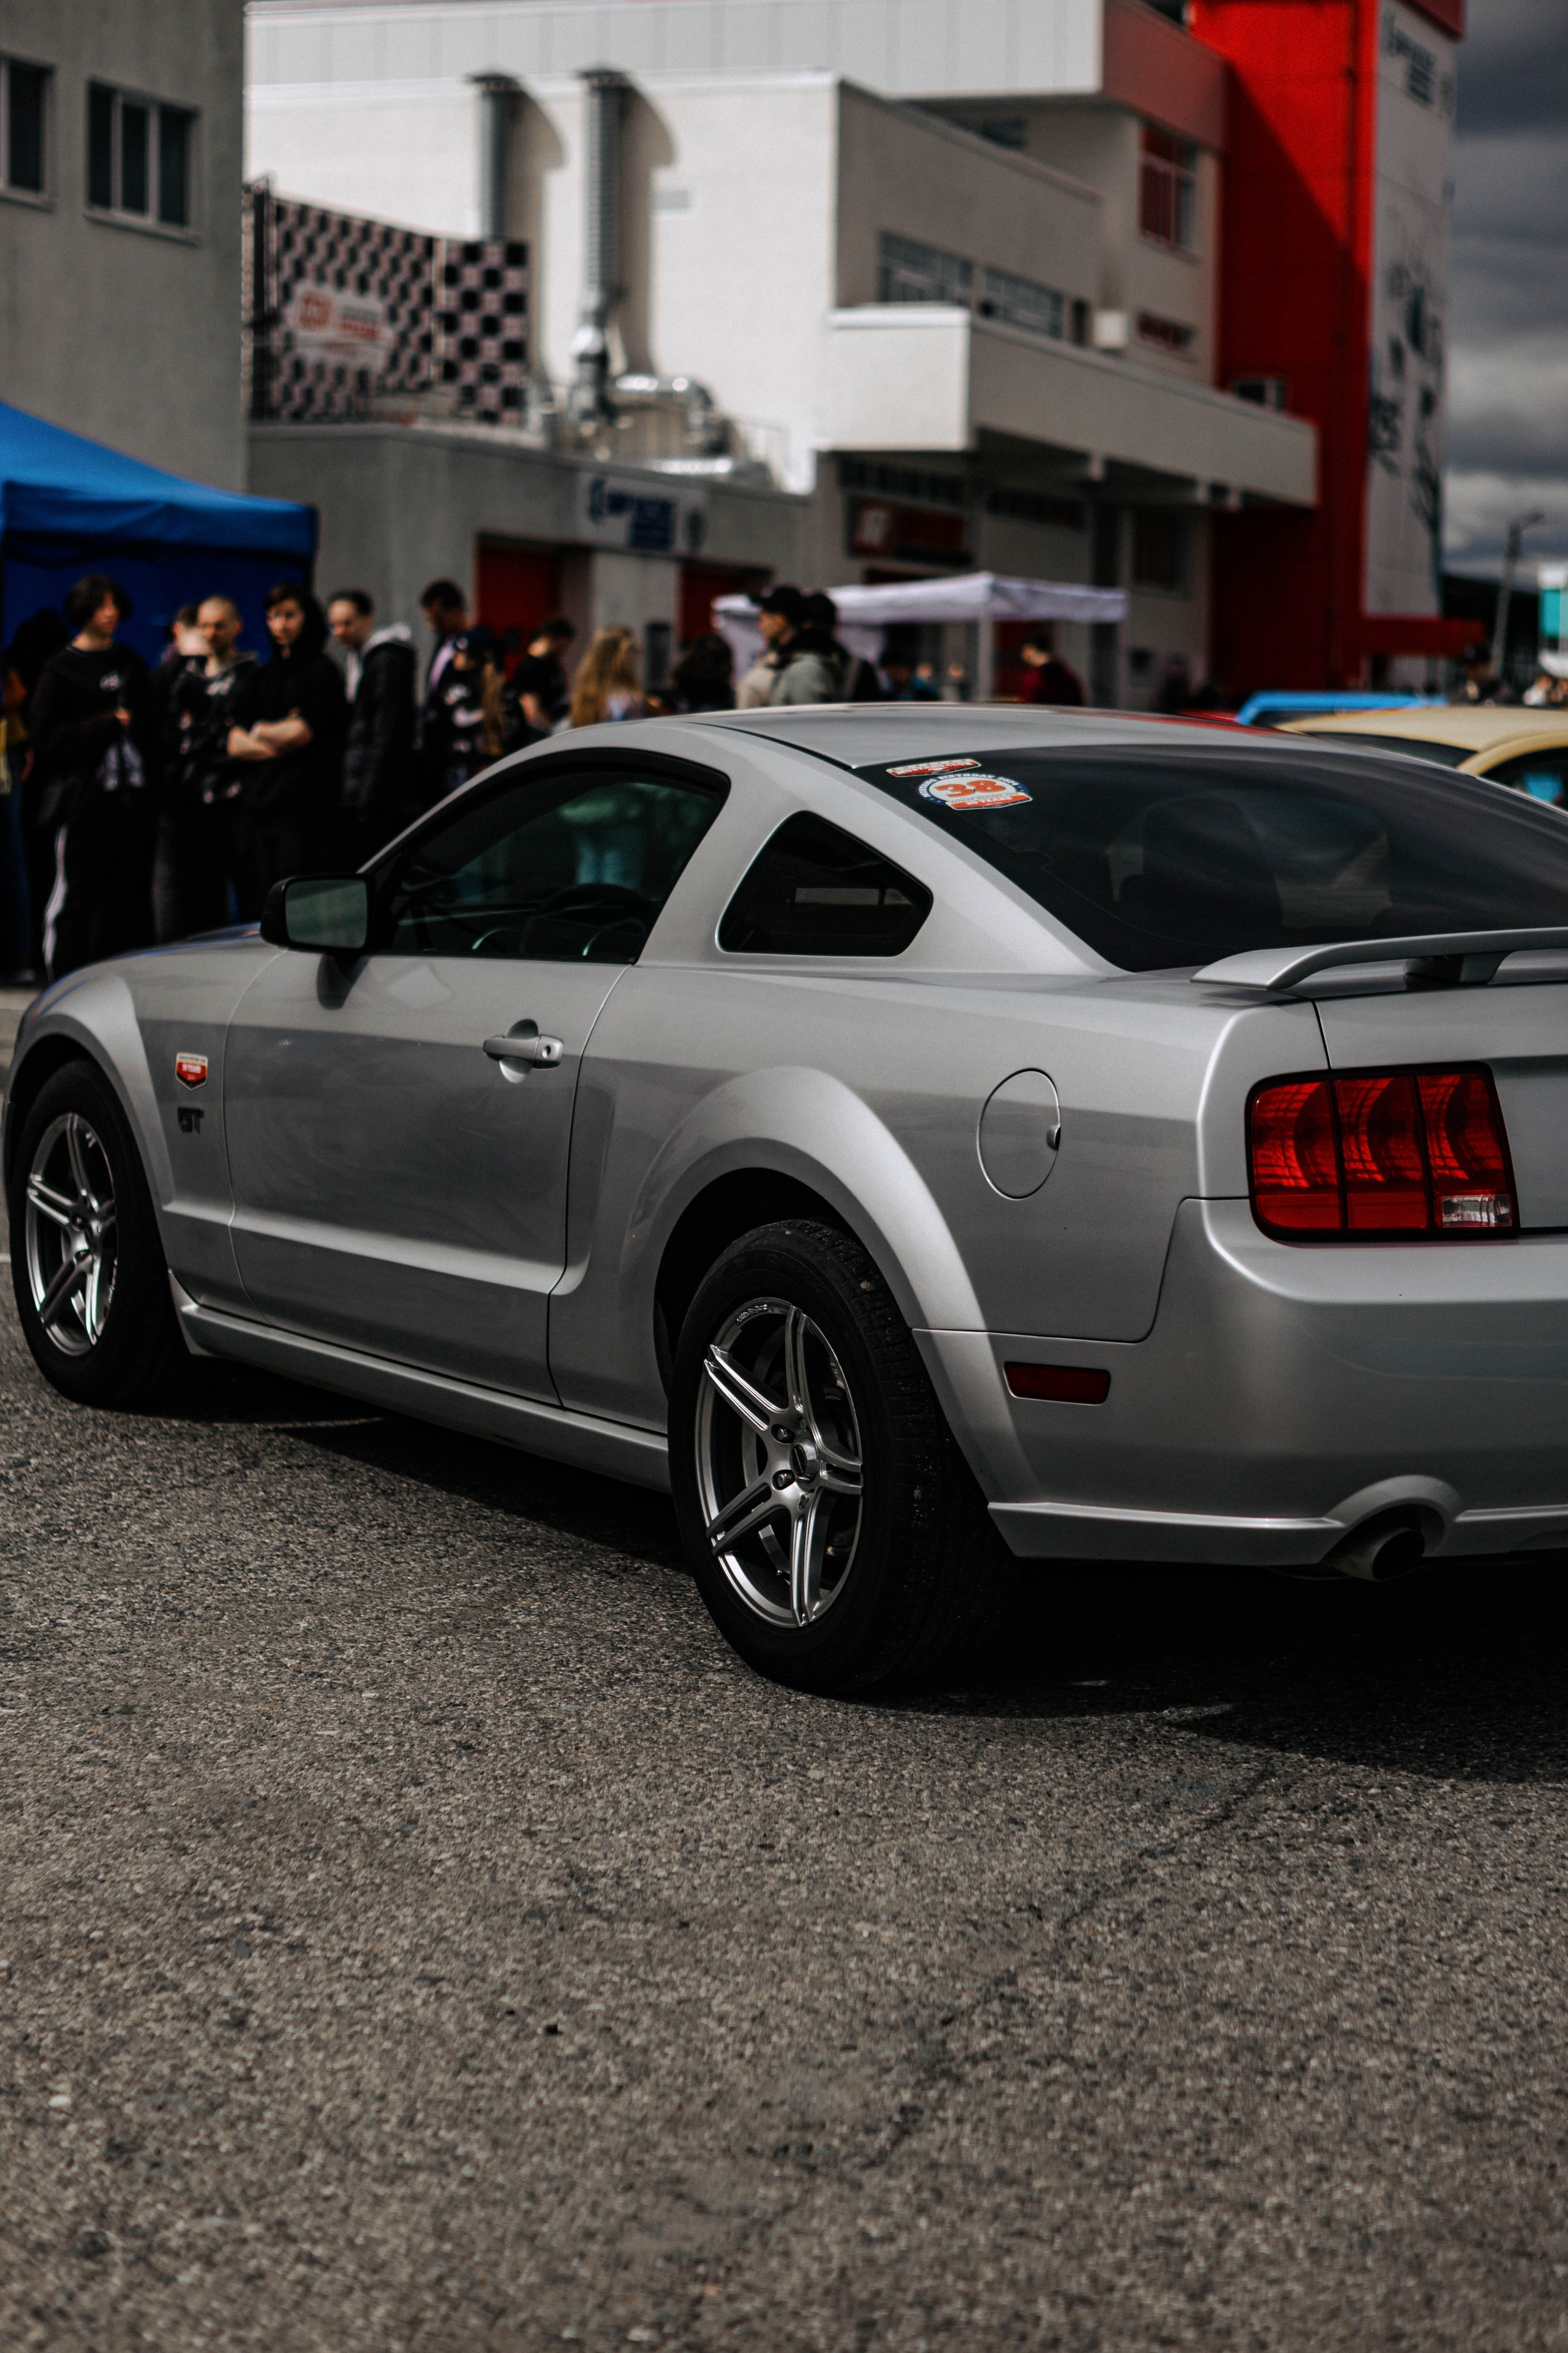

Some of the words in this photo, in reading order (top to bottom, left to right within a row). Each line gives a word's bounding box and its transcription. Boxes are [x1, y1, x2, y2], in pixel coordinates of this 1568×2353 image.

[897, 764, 944, 774] MUSTANG
[918, 778, 937, 798] MUSTANG
[935, 780, 1006, 798] 38
[178, 1108, 204, 1133] GT
